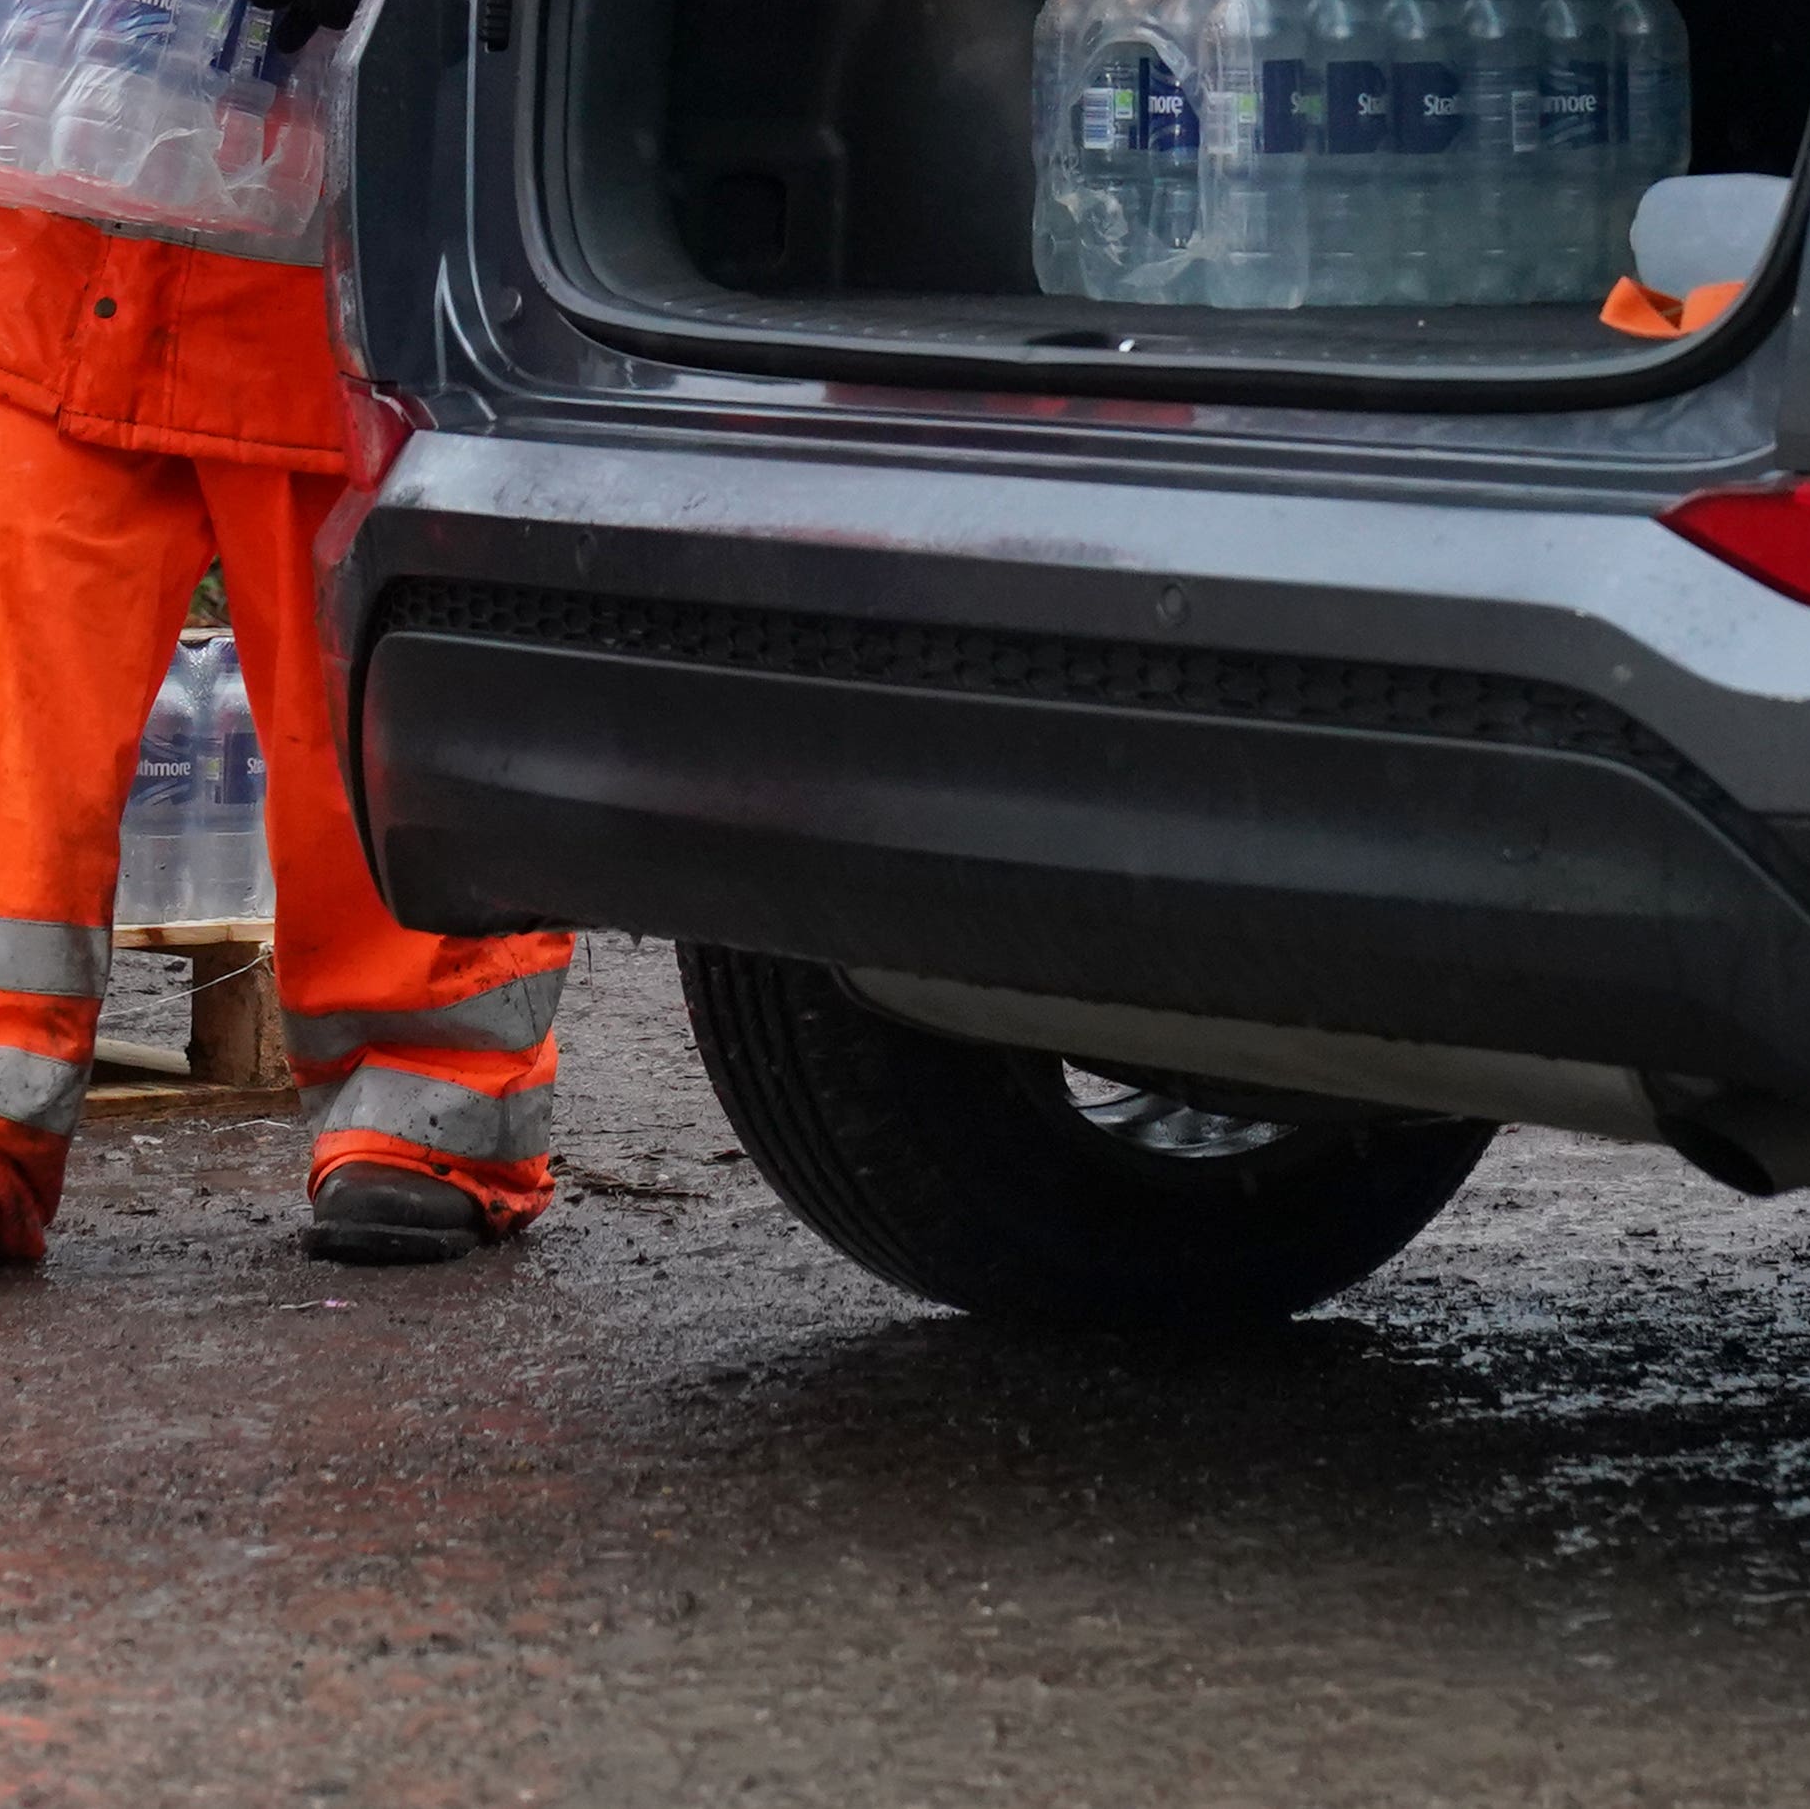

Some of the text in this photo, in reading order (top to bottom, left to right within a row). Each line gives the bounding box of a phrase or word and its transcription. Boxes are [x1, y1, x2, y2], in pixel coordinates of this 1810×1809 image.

[1148, 95, 1184, 116] more
[1546, 94, 1598, 113] more
[136, 759, 191, 777] thmore
